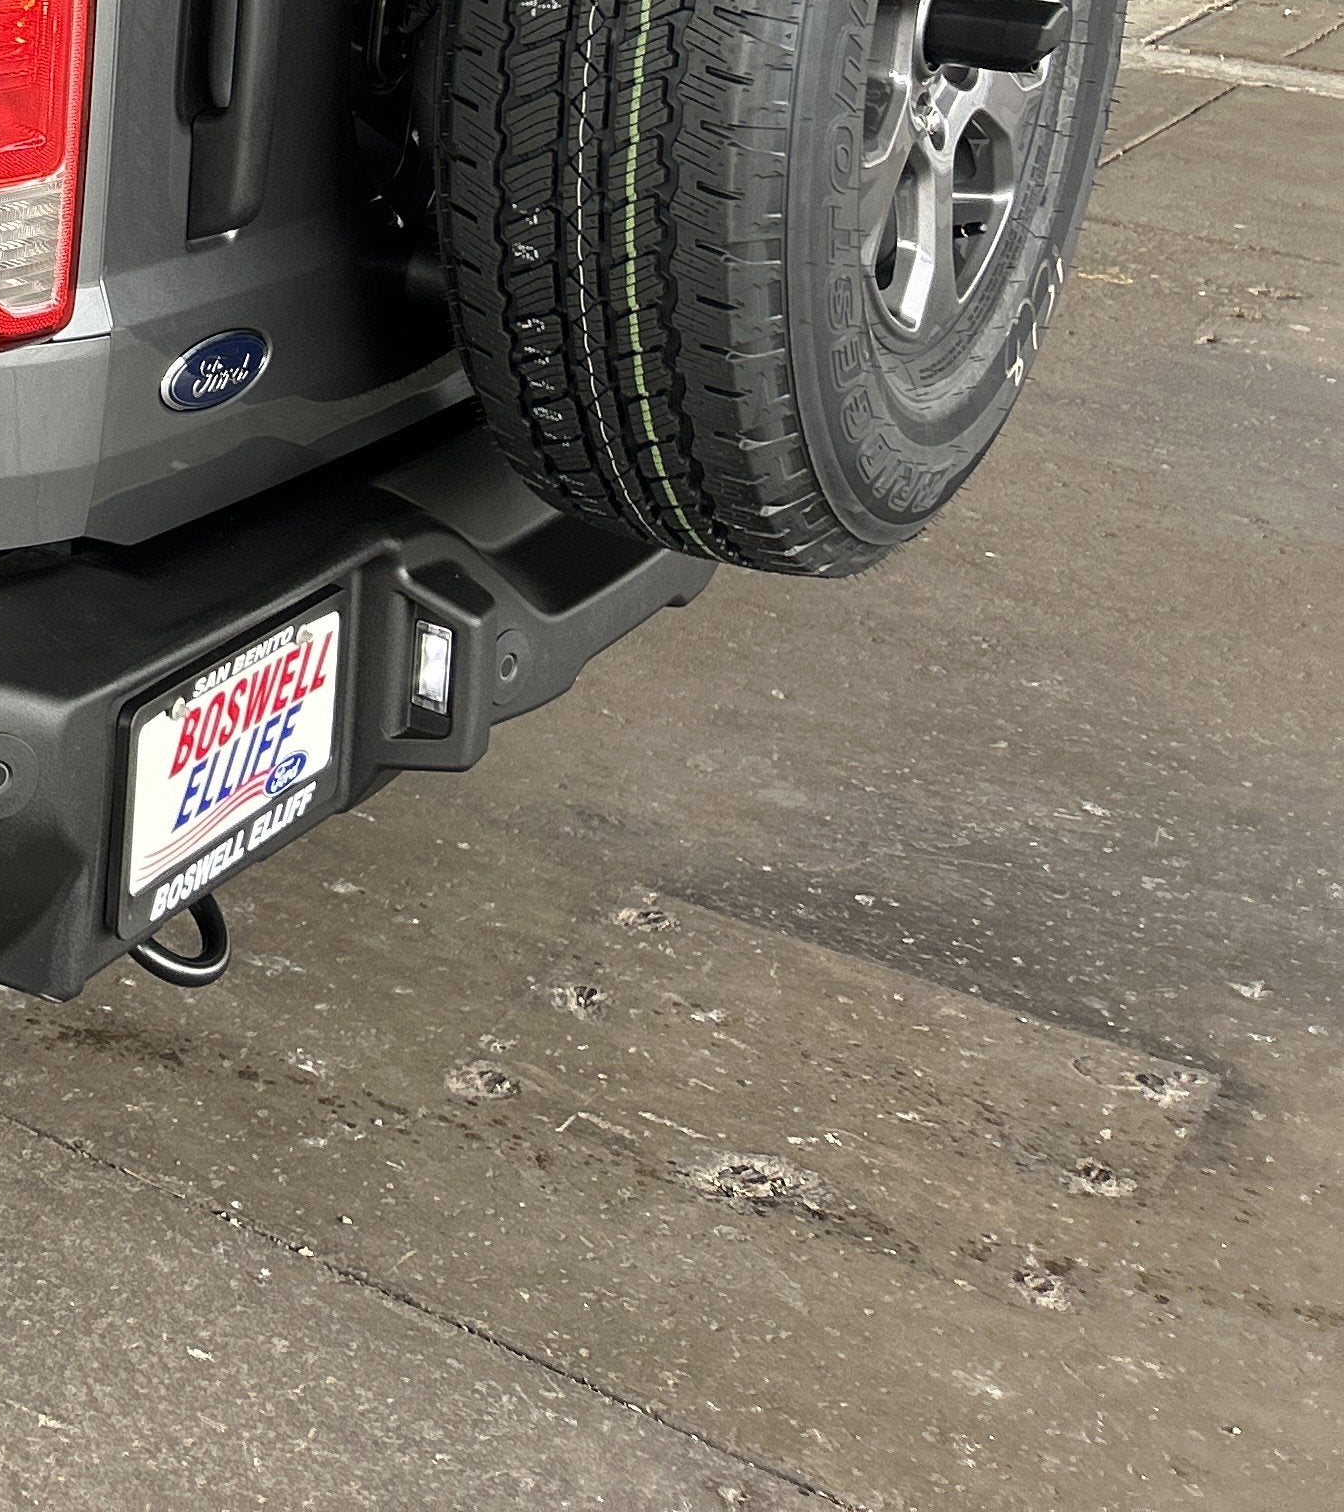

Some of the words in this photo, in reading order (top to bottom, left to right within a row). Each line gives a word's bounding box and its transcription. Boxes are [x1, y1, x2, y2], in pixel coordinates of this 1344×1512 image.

[192, 353, 251, 399] Ford
[168, 630, 334, 780] BOSWELL
[192, 661, 232, 698] SAN
[231, 625, 295, 676] BENITO
[170, 700, 304, 833] ELLIFF
[149, 829, 245, 922] BOSWELL
[246, 781, 317, 852] ELLIFF
